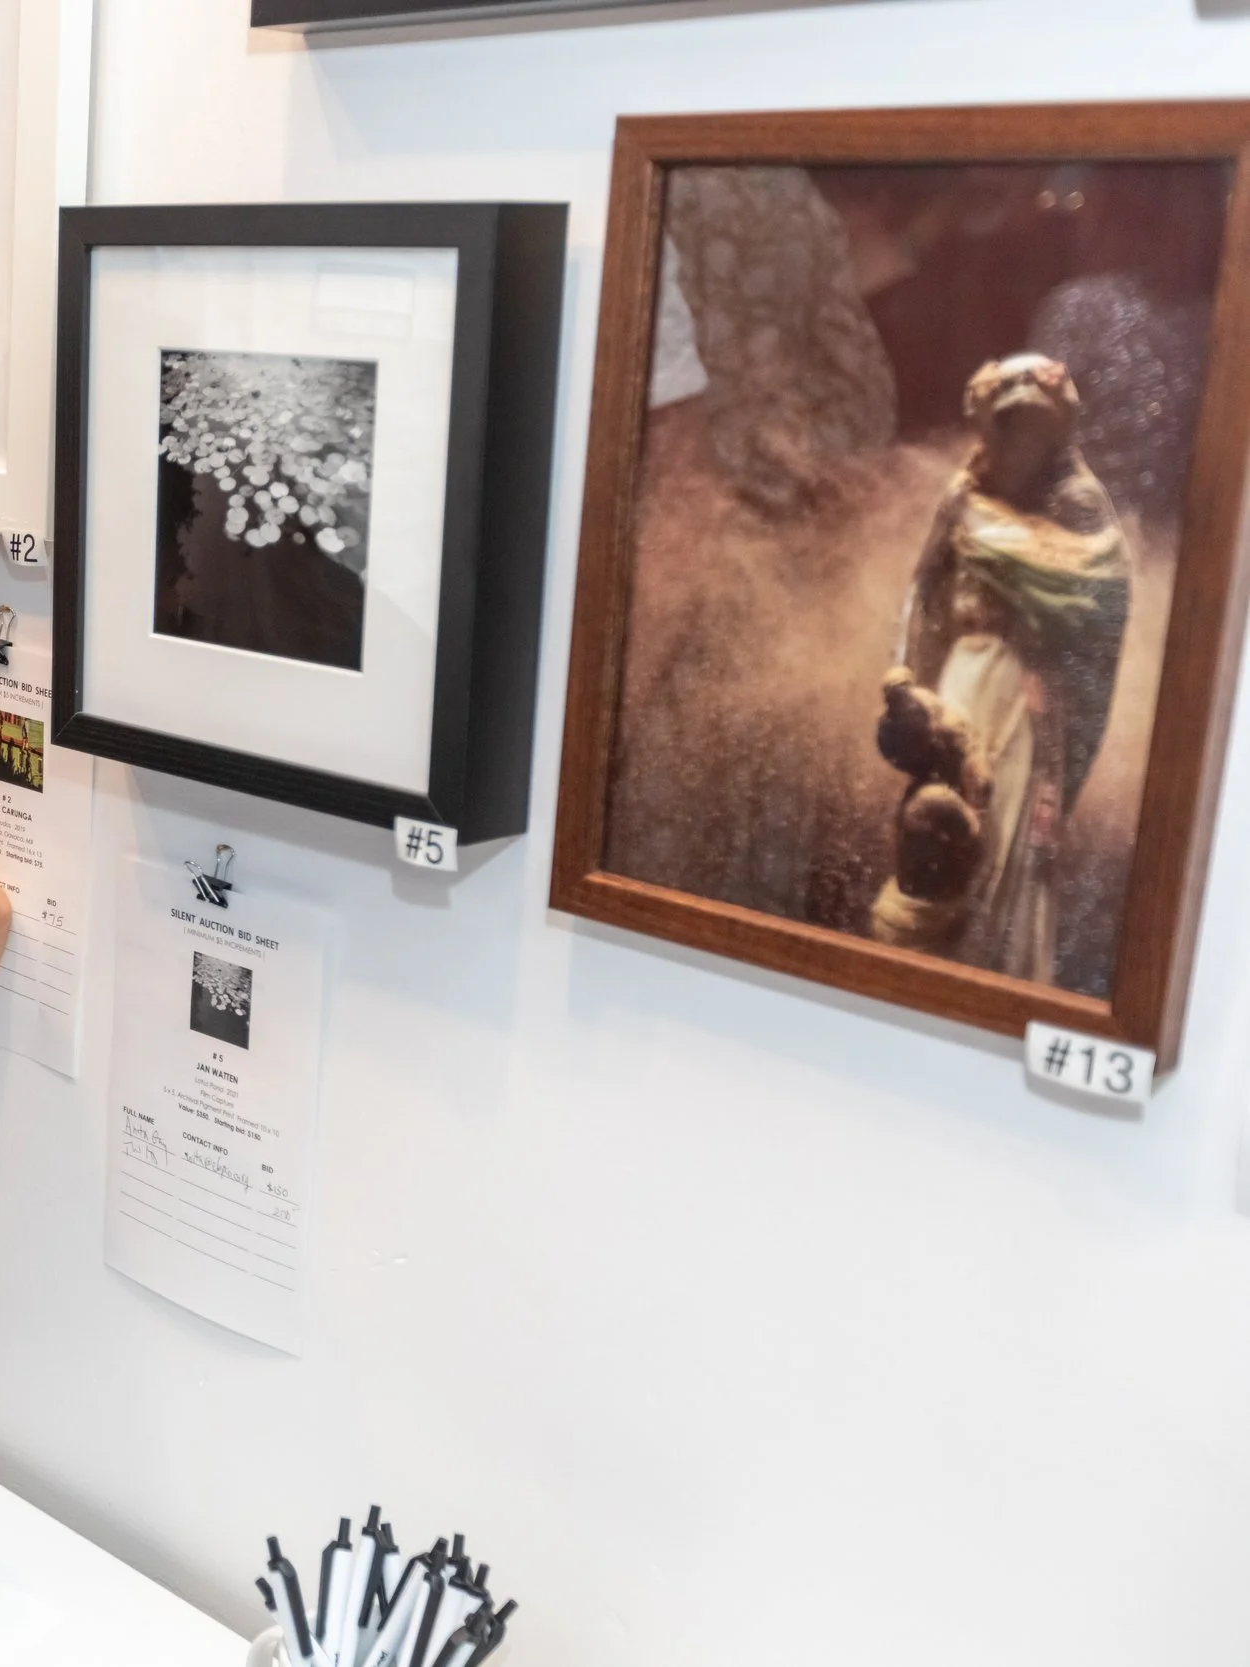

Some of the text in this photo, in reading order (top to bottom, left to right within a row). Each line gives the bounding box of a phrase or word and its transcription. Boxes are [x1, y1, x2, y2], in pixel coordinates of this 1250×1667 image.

[10, 533, 38, 562] #2
[21, 684, 33, 693] BID
[35, 687, 53, 699] SHEE
[10, 694, 41, 708] INCREMENTS
[2, 807, 33, 822] CARUNGA
[406, 826, 444, 864] #5
[5, 851, 24, 863] Starting
[6, 885, 21, 894] INFO
[46, 899, 57, 907] BID
[170, 908, 280, 951] SILENT AUCTION BID SHEET
[187, 929, 215, 942] MINIMUM
[224, 940, 262, 958] INCREMENTS
[1044, 1036, 1135, 1094] #13
[196, 1063, 239, 1085] JAN WATTEN
[177, 1092, 199, 1106] Archival
[199, 1099, 222, 1114] Pigment
[211, 1094, 235, 1109] Capture
[123, 1106, 155, 1126] FULL NAME
[213, 1117, 235, 1132] Starting
[182, 1132, 229, 1156] CONTACT INFO
[261, 1164, 274, 1174] BID
